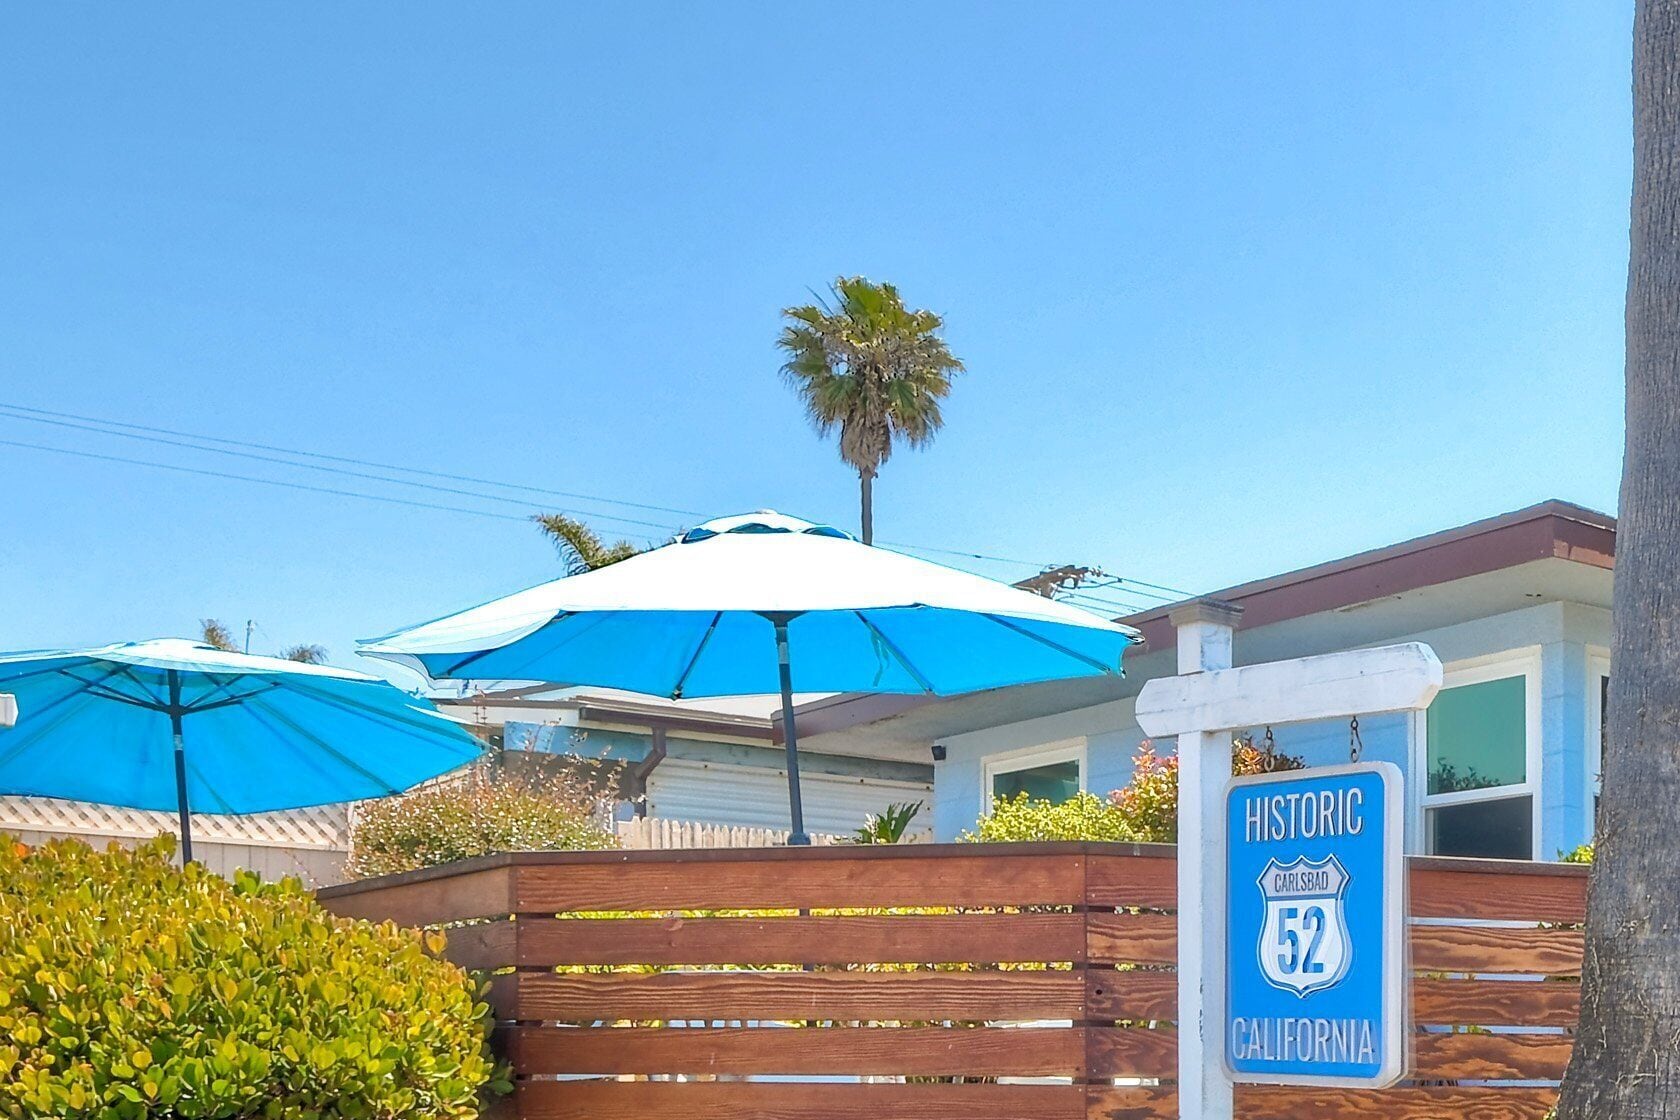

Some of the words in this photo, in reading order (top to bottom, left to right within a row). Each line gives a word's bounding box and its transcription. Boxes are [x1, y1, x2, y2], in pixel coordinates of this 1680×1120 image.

[1245, 787, 1364, 843] HISTORIC
[1274, 871, 1329, 893] CARLSBAD
[1277, 905, 1326, 975] 52
[1232, 1016, 1375, 1064] CALIFORNIA
